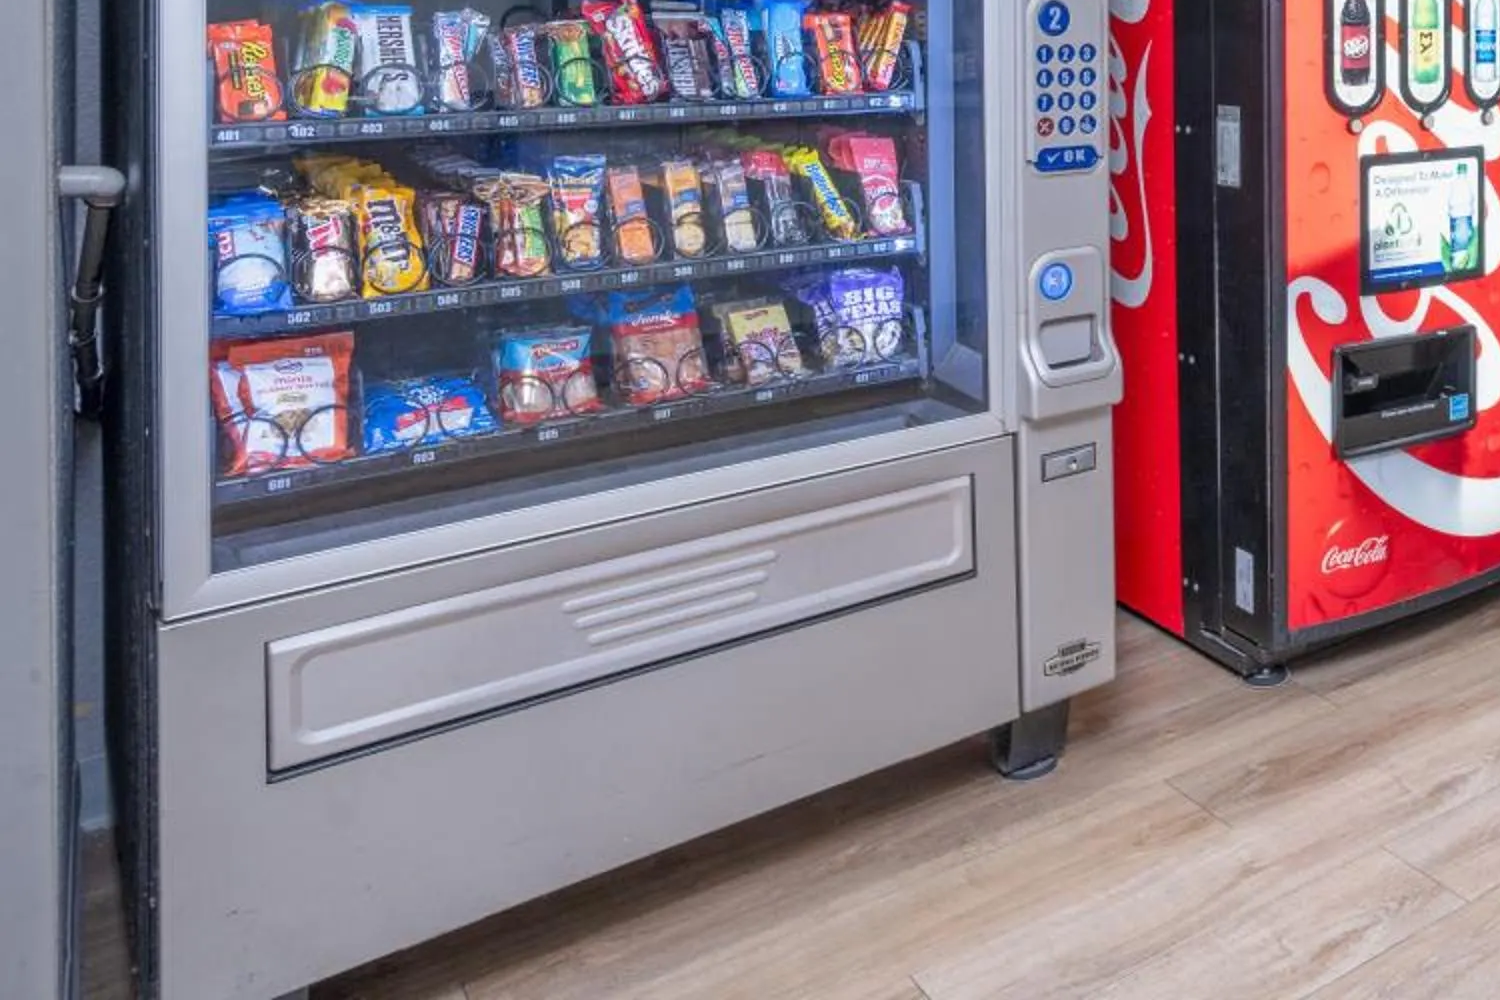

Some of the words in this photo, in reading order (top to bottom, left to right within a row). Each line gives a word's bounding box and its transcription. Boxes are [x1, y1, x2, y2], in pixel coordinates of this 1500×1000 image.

[1048, 6, 1061, 31] 2
[376, 14, 409, 83] HERSHES
[1039, 47, 1048, 61] 1
[1063, 149, 1086, 163] OK
[843, 286, 895, 307] BIG
[1320, 534, 1389, 575] Coca-Cola
